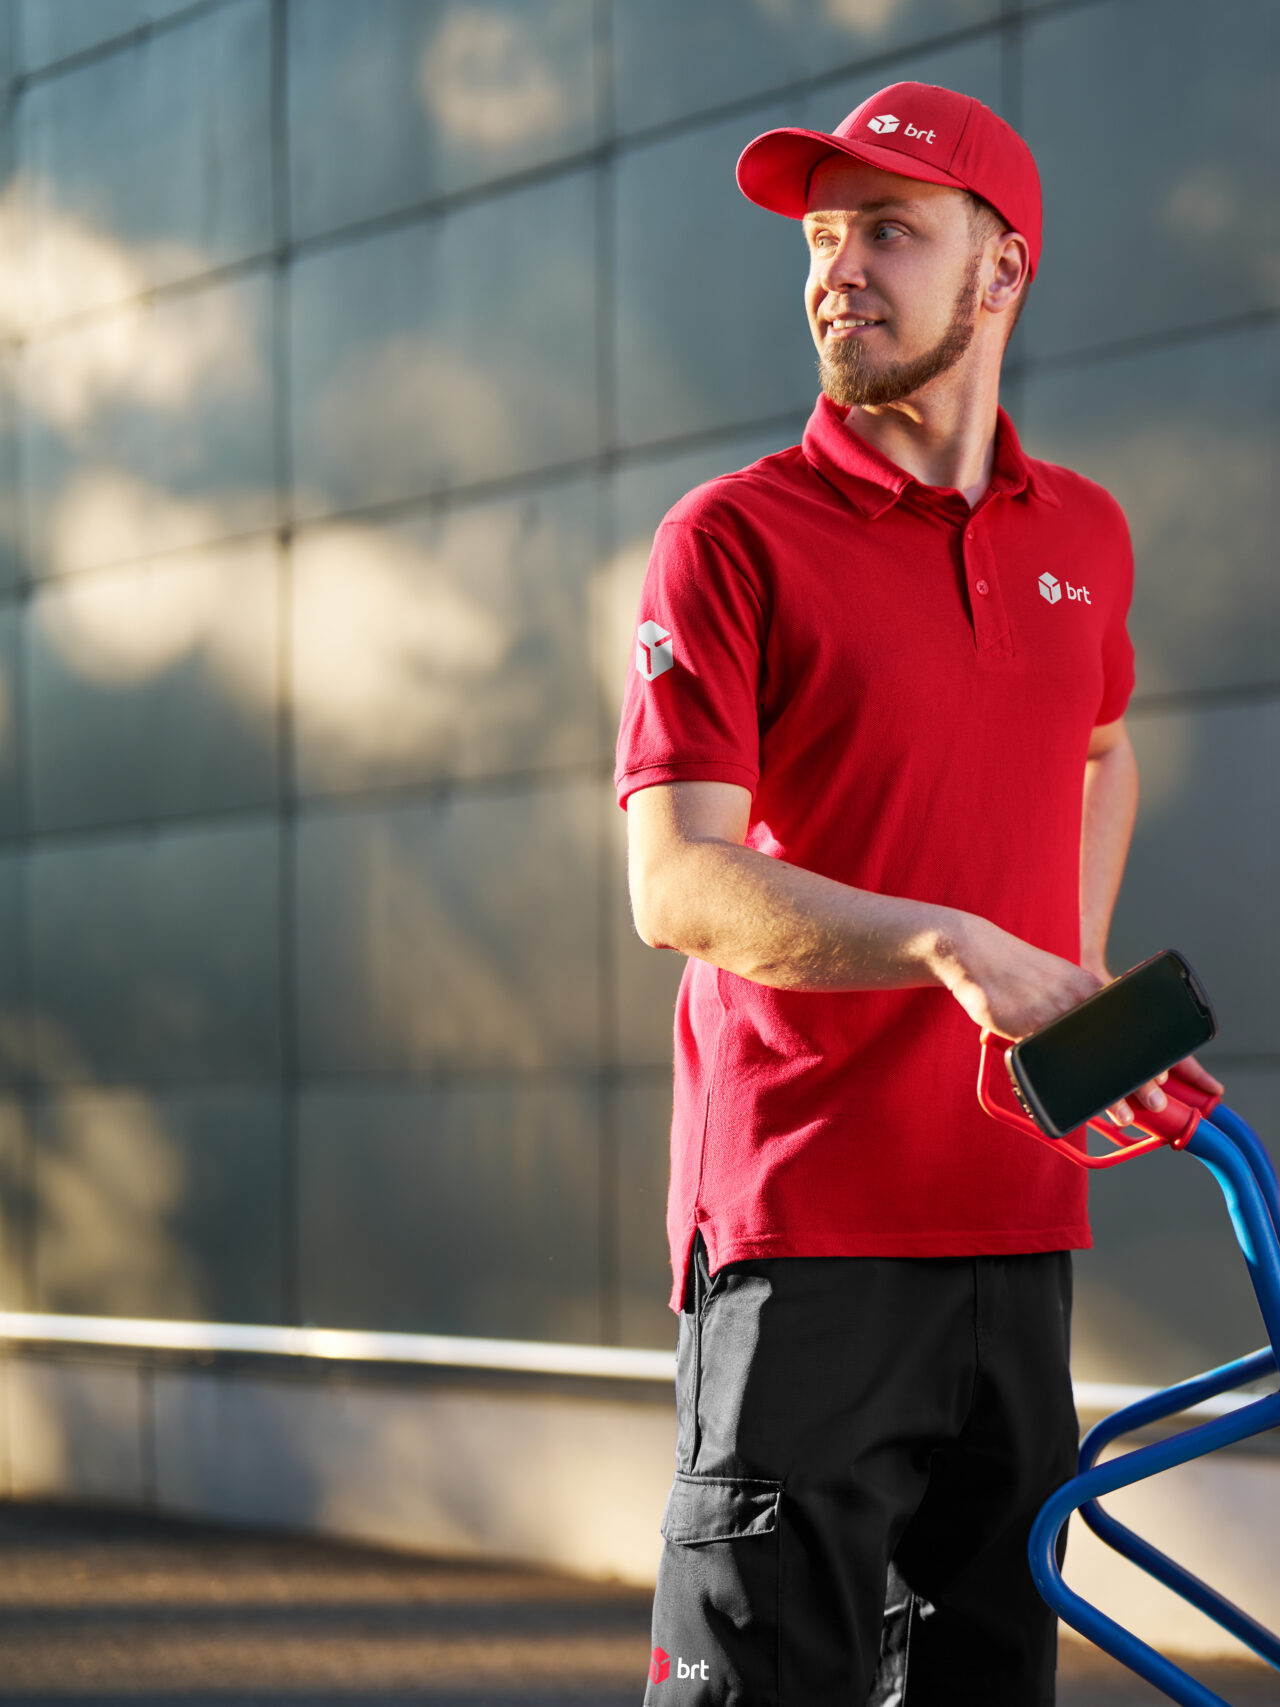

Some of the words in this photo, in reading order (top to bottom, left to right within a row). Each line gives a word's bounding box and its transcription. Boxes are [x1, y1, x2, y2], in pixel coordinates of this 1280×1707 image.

[903, 123, 936, 145] brt
[1065, 581, 1092, 605] brt
[677, 1656, 710, 1681] brt
